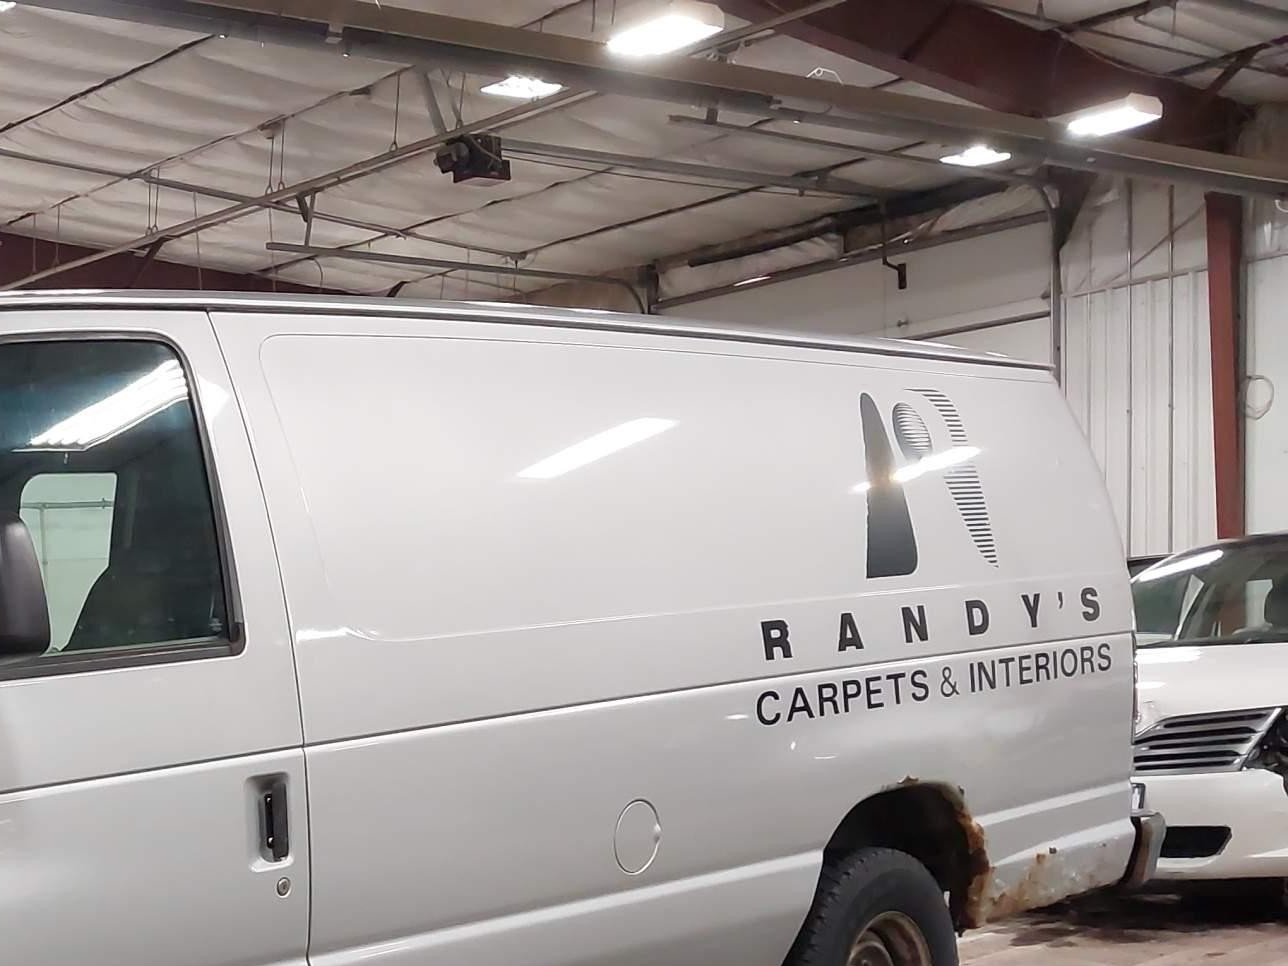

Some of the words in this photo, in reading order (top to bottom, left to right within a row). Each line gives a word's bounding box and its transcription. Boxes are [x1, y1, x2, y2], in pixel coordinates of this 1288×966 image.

[760, 587, 1101, 661] RANDY'S
[756, 670, 930, 726] CARPETS
[940, 666, 960, 698] &
[969, 642, 1112, 693] INTERIORS
